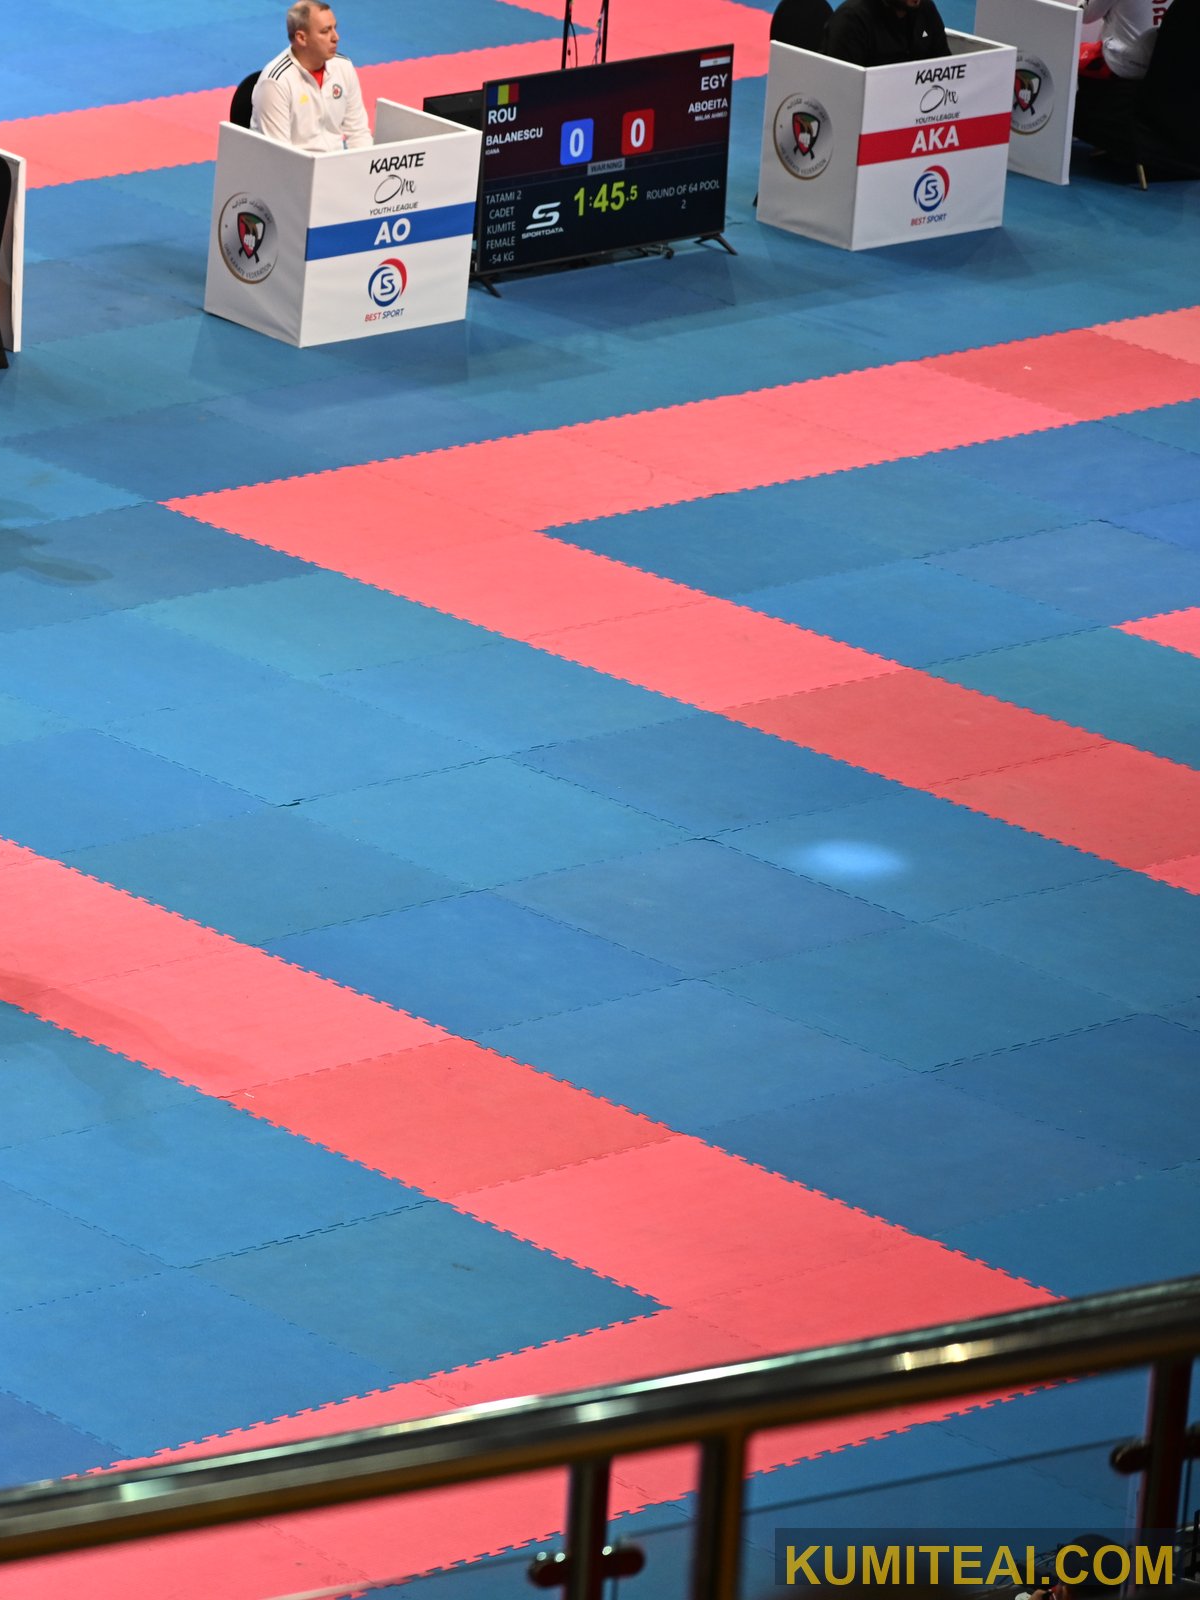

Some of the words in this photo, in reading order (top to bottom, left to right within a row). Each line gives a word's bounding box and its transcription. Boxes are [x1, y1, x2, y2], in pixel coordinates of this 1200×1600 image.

[701, 73, 728, 91] EGY
[915, 64, 967, 85] KARATE
[688, 97, 728, 113] ABOEITA
[487, 106, 517, 125] ROU
[485, 127, 544, 146] BALANESCU
[630, 118, 646, 148] 0
[911, 125, 960, 154] AKA
[569, 128, 584, 158] 0
[369, 151, 426, 175] KARATE
[590, 160, 624, 173] WARNING
[646, 187, 675, 200] ROUND
[676, 184, 687, 196] OF
[688, 182, 698, 193] 64
[700, 179, 720, 190] POOL
[485, 191, 515, 205] TATAMI
[516, 190, 522, 200] 2
[681, 200, 686, 209] 2
[369, 206, 391, 216] YOUTH
[392, 201, 419, 212] LEAGUE
[489, 206, 514, 220] CADET
[911, 215, 926, 226] BEST
[927, 213, 947, 224] SPORT
[374, 217, 411, 246] AO
[487, 221, 516, 235] KUMITE
[521, 227, 564, 239] SPORTDATA
[486, 236, 516, 250] FEMALE
[503, 251, 514, 262] KG
[365, 312, 381, 322] BEST
[382, 308, 404, 319] SPORT
